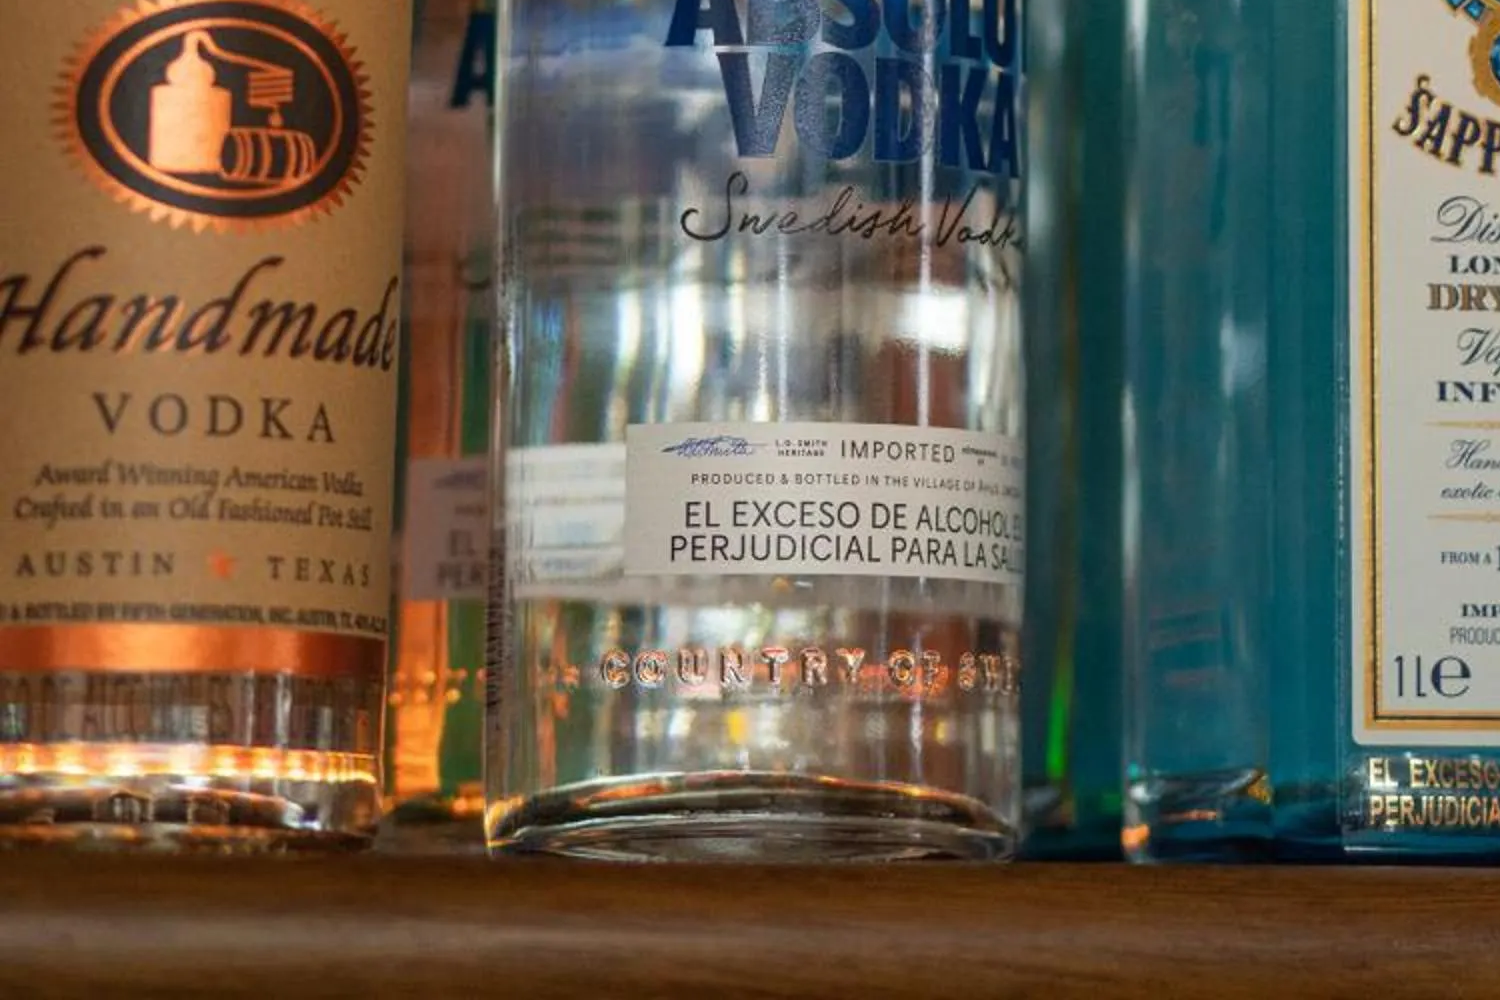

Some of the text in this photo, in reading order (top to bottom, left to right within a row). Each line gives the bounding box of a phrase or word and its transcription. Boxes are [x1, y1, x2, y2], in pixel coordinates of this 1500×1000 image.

[716, 51, 1020, 178] VODKA
[680, 172, 926, 241] Swedish
[0, 246, 398, 372] Handmade
[92, 392, 337, 444] VODKA
[841, 439, 956, 463] IMPORTED
[691, 473, 776, 485] PRODUCED
[780, 473, 789, 485] &
[795, 473, 861, 486] BOTTLED
[865, 475, 879, 486] IN
[884, 475, 909, 488] THE
[913, 476, 961, 491] VILLAGE
[1440, 480, 1494, 500] exotic
[685, 500, 721, 529] EL
[732, 500, 861, 530] EXCESO
[871, 502, 908, 530] DE
[670, 533, 881, 563] PERJUDICIAL
[891, 535, 957, 567] PARA
[963, 539, 987, 568] LA
[1440, 551, 1483, 566] FROM
[1484, 552, 1493, 565] A
[15, 551, 370, 588] AUSTIN TEXAS
[600, 647, 866, 690] COUNTRY
[1368, 757, 1398, 789] EL
[1409, 758, 1499, 791] EXCESO
